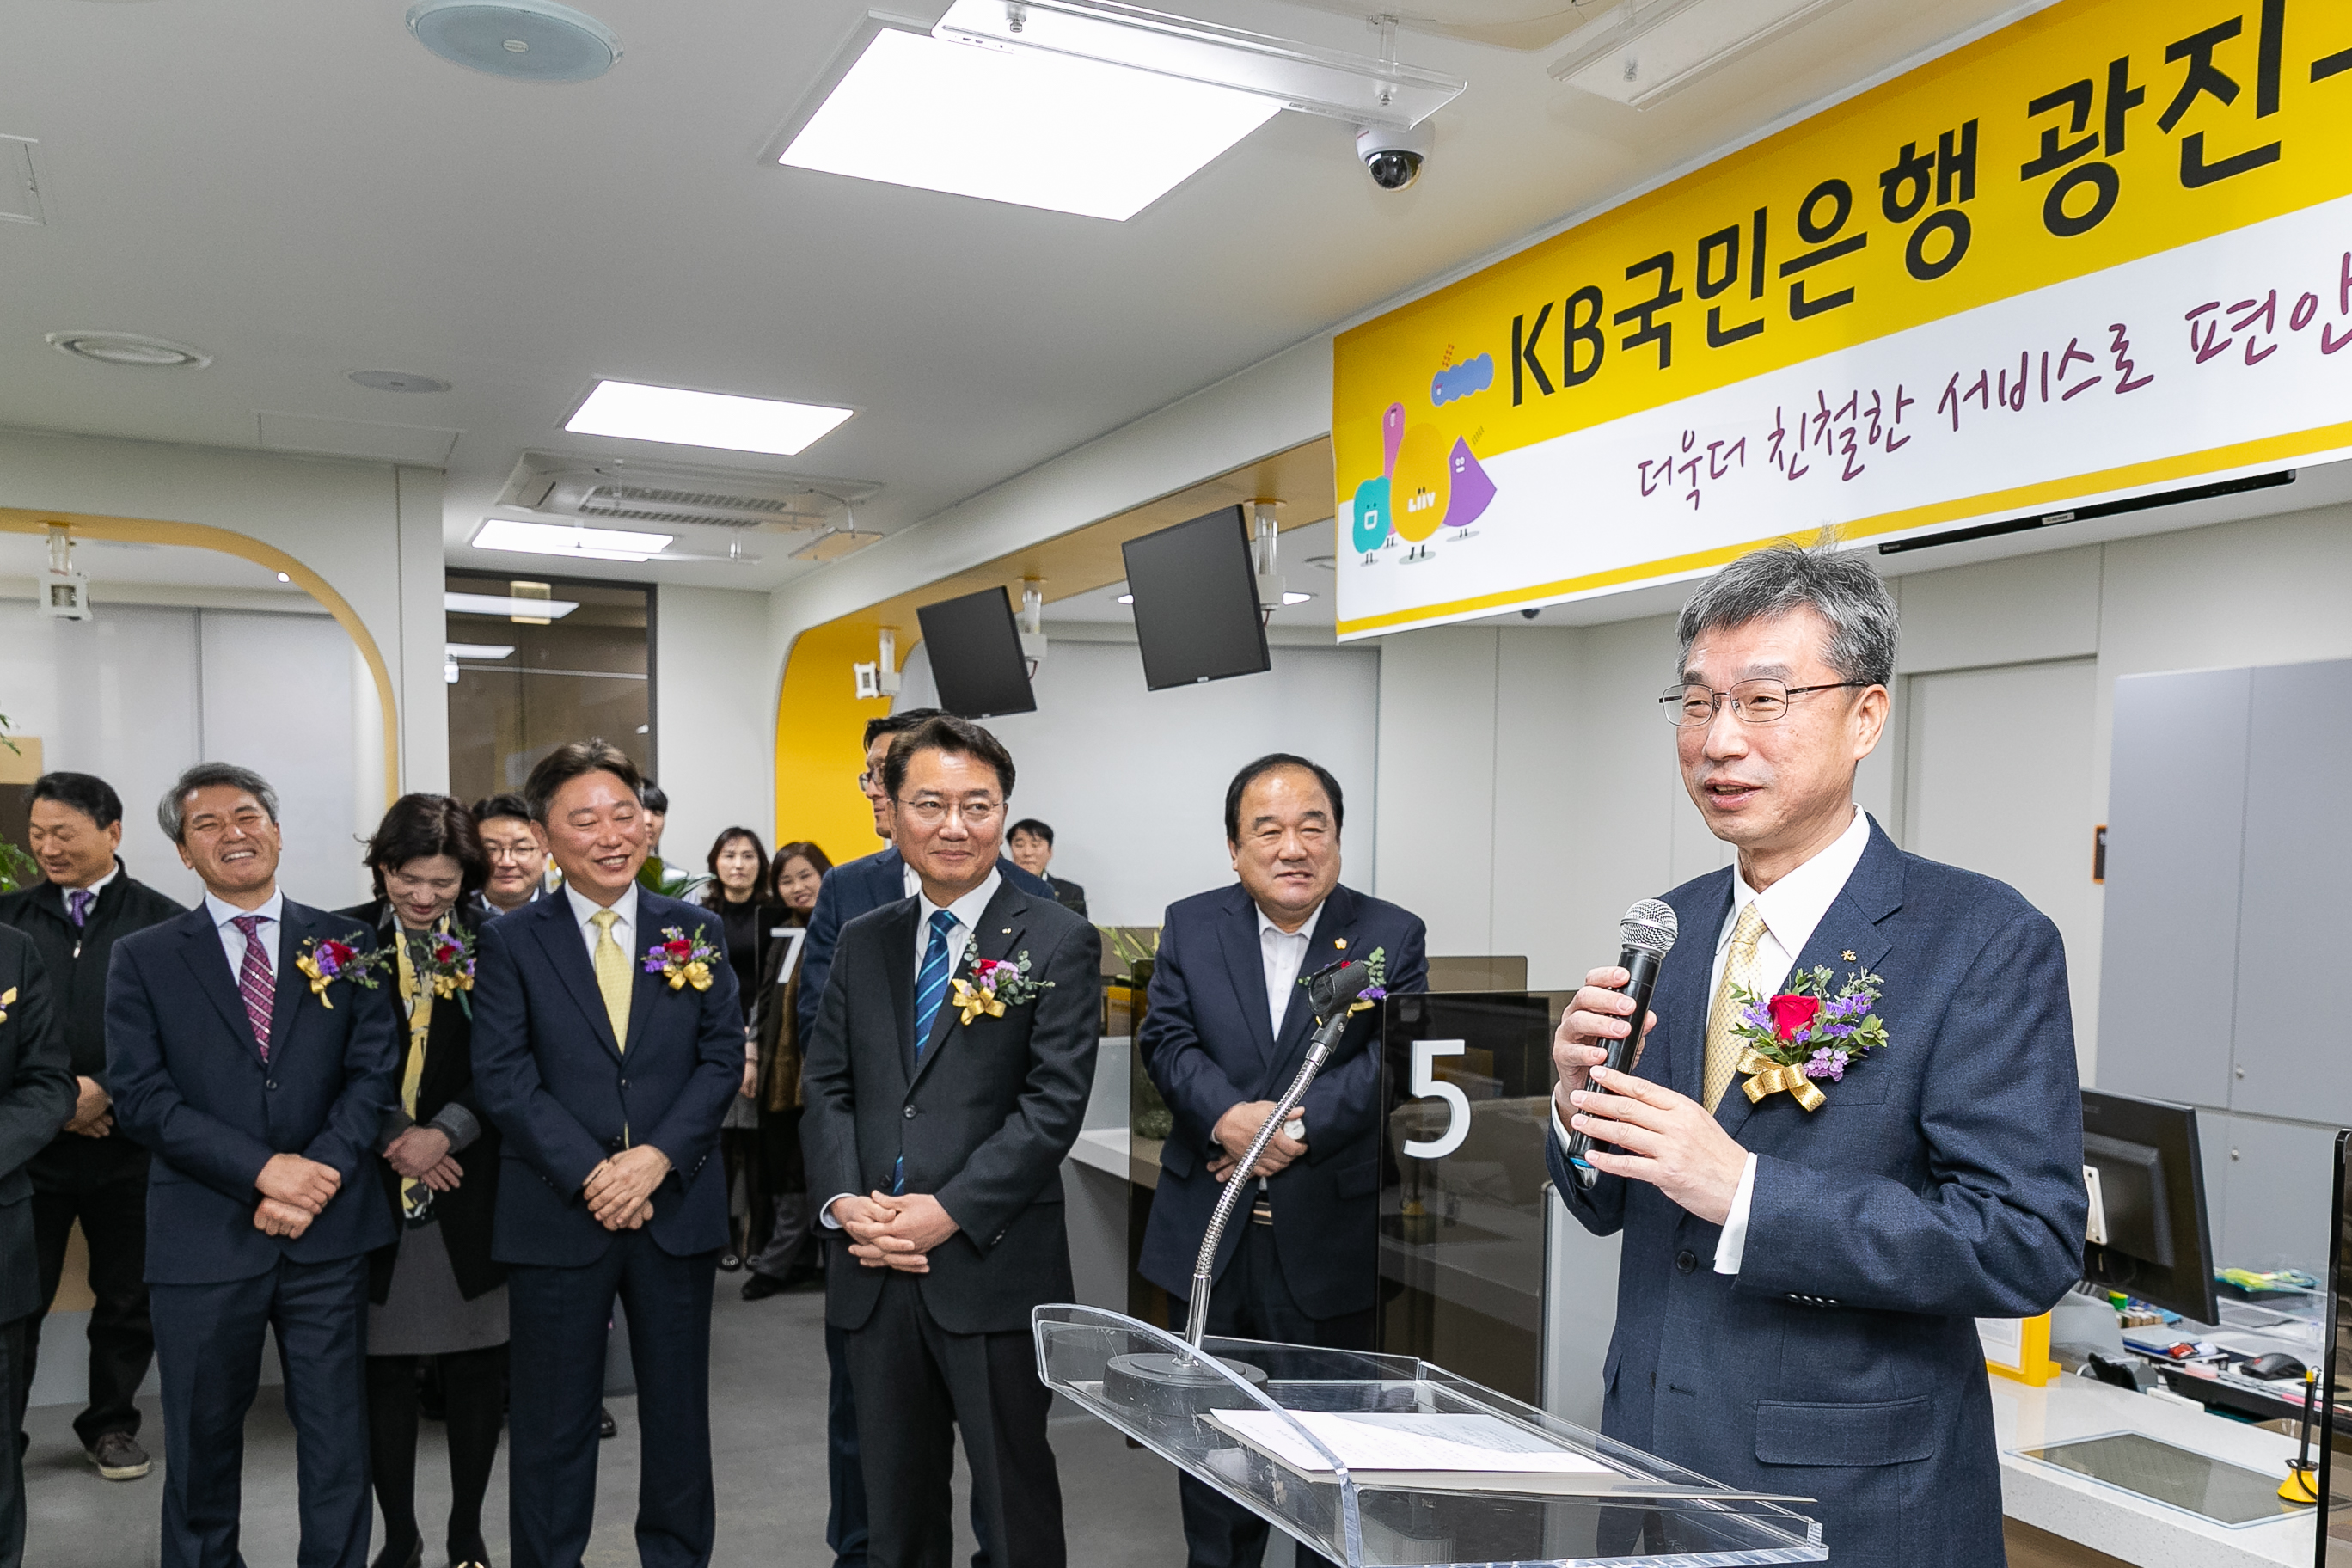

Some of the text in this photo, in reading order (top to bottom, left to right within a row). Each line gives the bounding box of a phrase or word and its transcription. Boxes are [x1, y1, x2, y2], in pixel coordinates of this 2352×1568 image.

[1510, 0, 2352, 407] KB국민은행 광진
[1638, 429, 1747, 511] 더욱더
[1938, 323, 2154, 432] 서비스로
[769, 927, 807, 984] 7
[1403, 1039, 1472, 1159] 5
